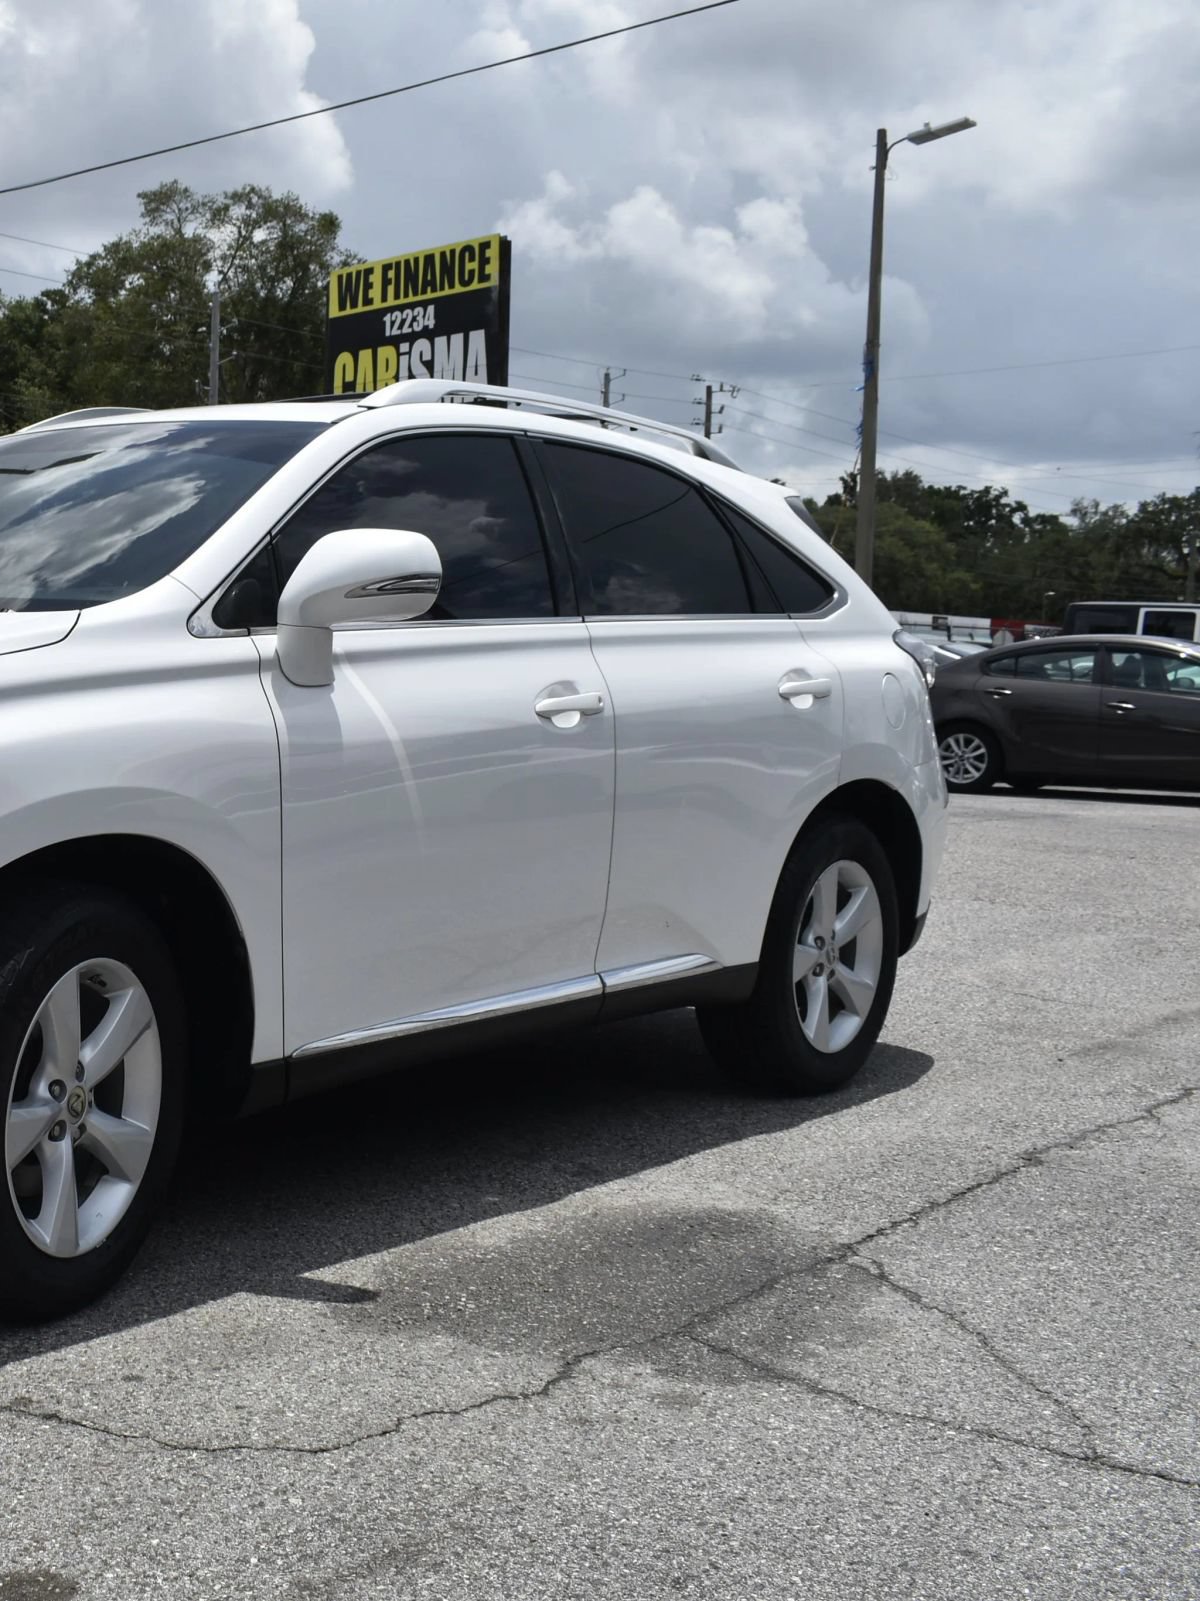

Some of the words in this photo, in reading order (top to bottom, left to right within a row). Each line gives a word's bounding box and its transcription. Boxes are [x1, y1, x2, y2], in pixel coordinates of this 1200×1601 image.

[337, 266, 374, 312] WE
[381, 240, 492, 303] FINANCE
[383, 304, 435, 337] 12234
